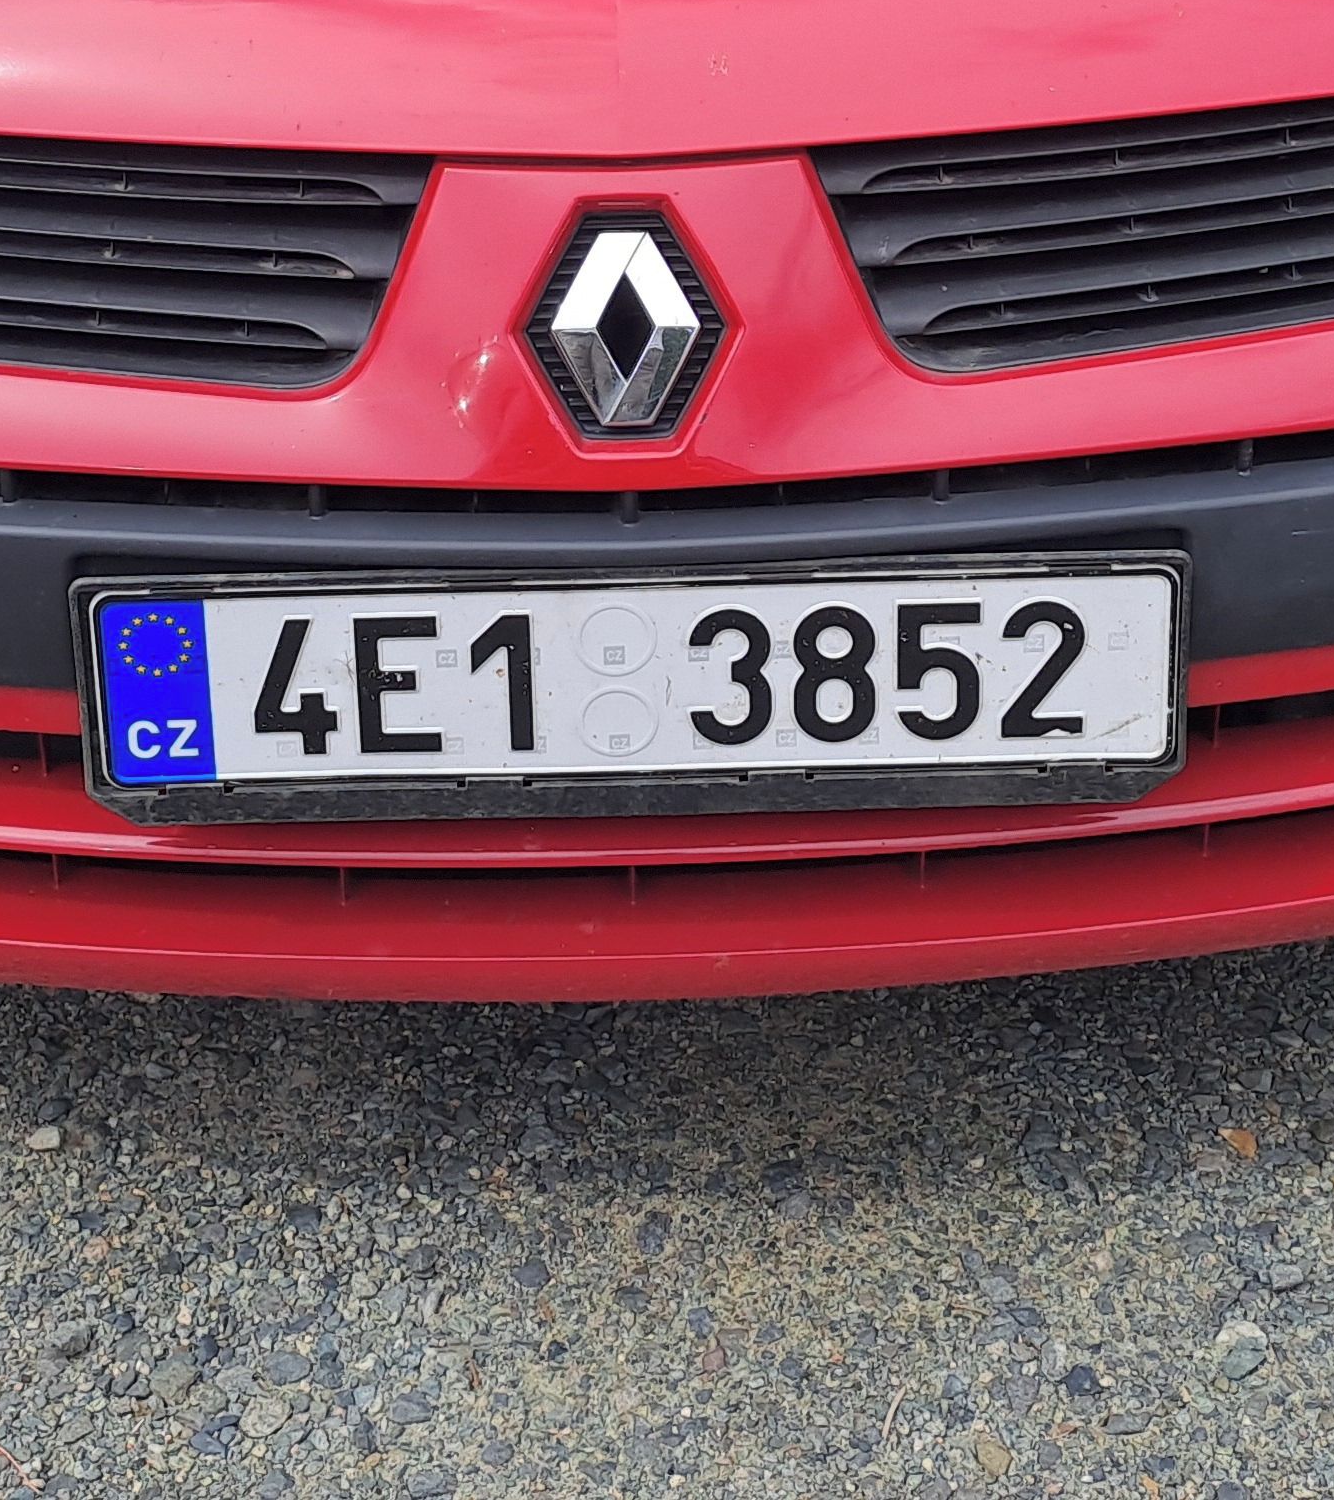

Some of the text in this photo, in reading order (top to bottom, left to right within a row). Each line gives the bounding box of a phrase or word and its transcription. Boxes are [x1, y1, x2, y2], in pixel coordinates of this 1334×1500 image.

[127, 600, 1086, 759] CZ 4E1 3852
